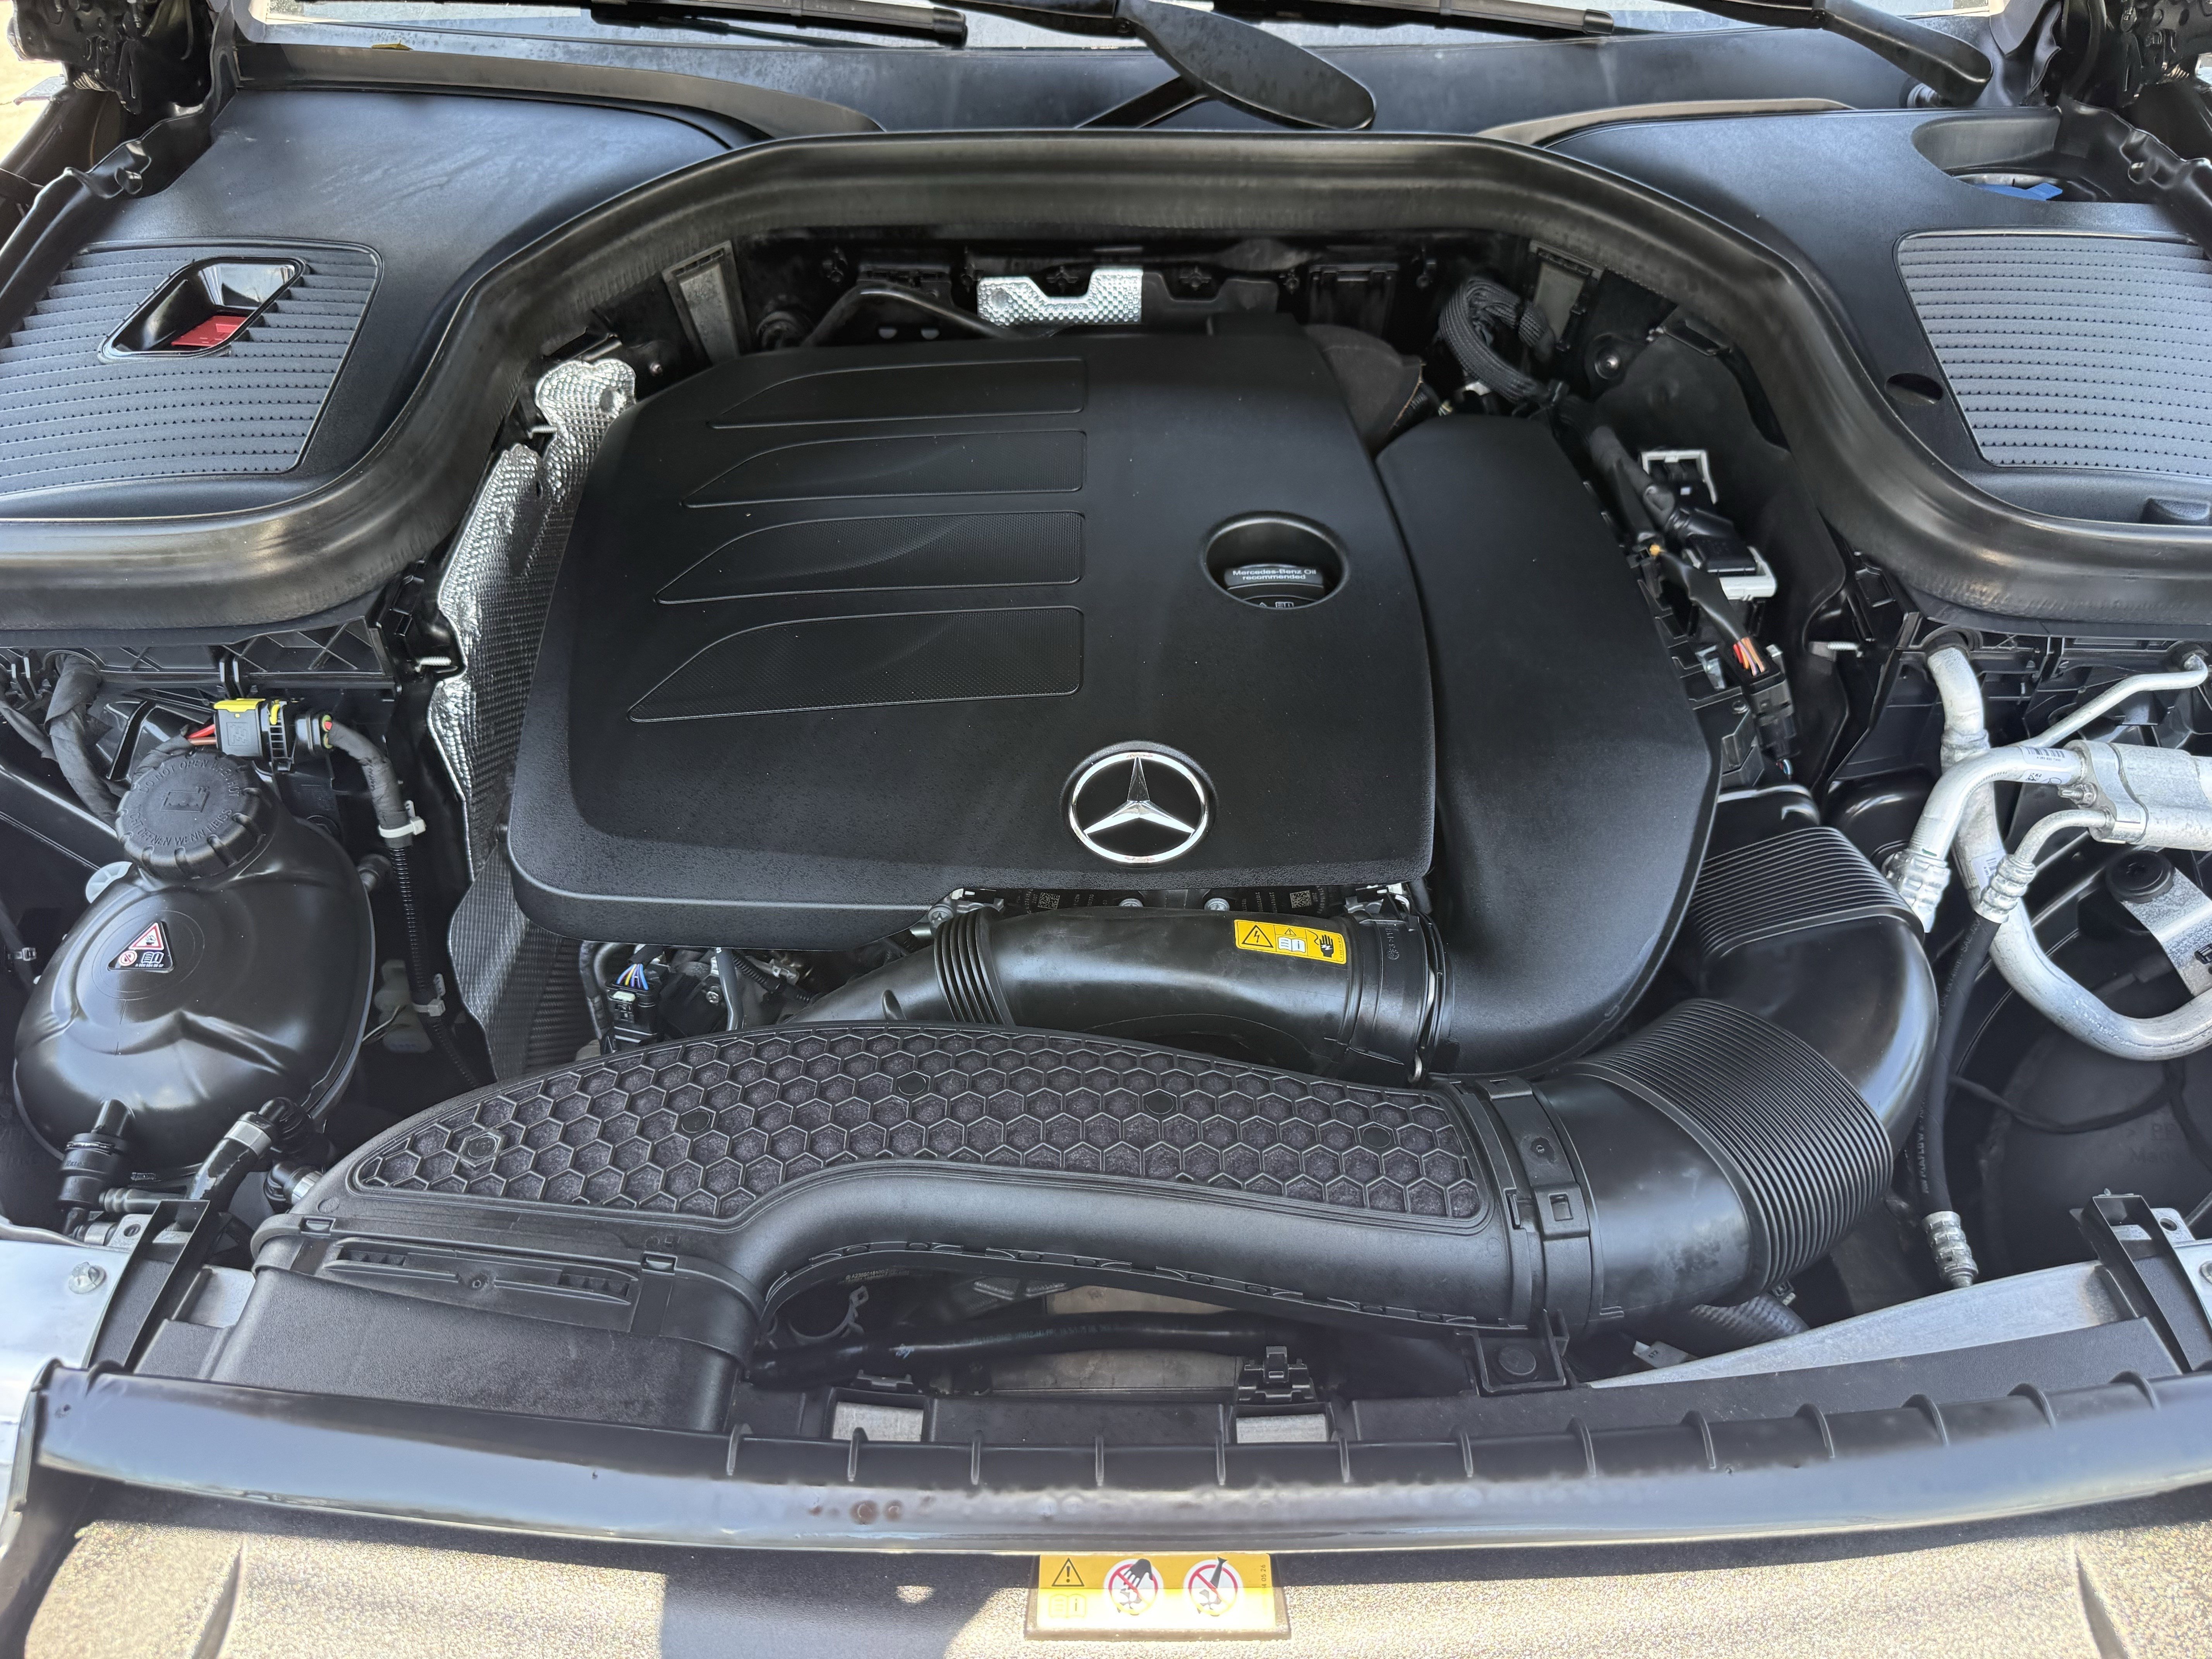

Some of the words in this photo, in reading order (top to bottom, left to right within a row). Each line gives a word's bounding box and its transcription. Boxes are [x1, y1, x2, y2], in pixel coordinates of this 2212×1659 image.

[139, 780, 155, 793] DO
[156, 765, 175, 781] NOT
[179, 759, 209, 769] OPEN
[206, 808, 232, 832] HEISS
[1261, 1573, 1266, 1582] 05
